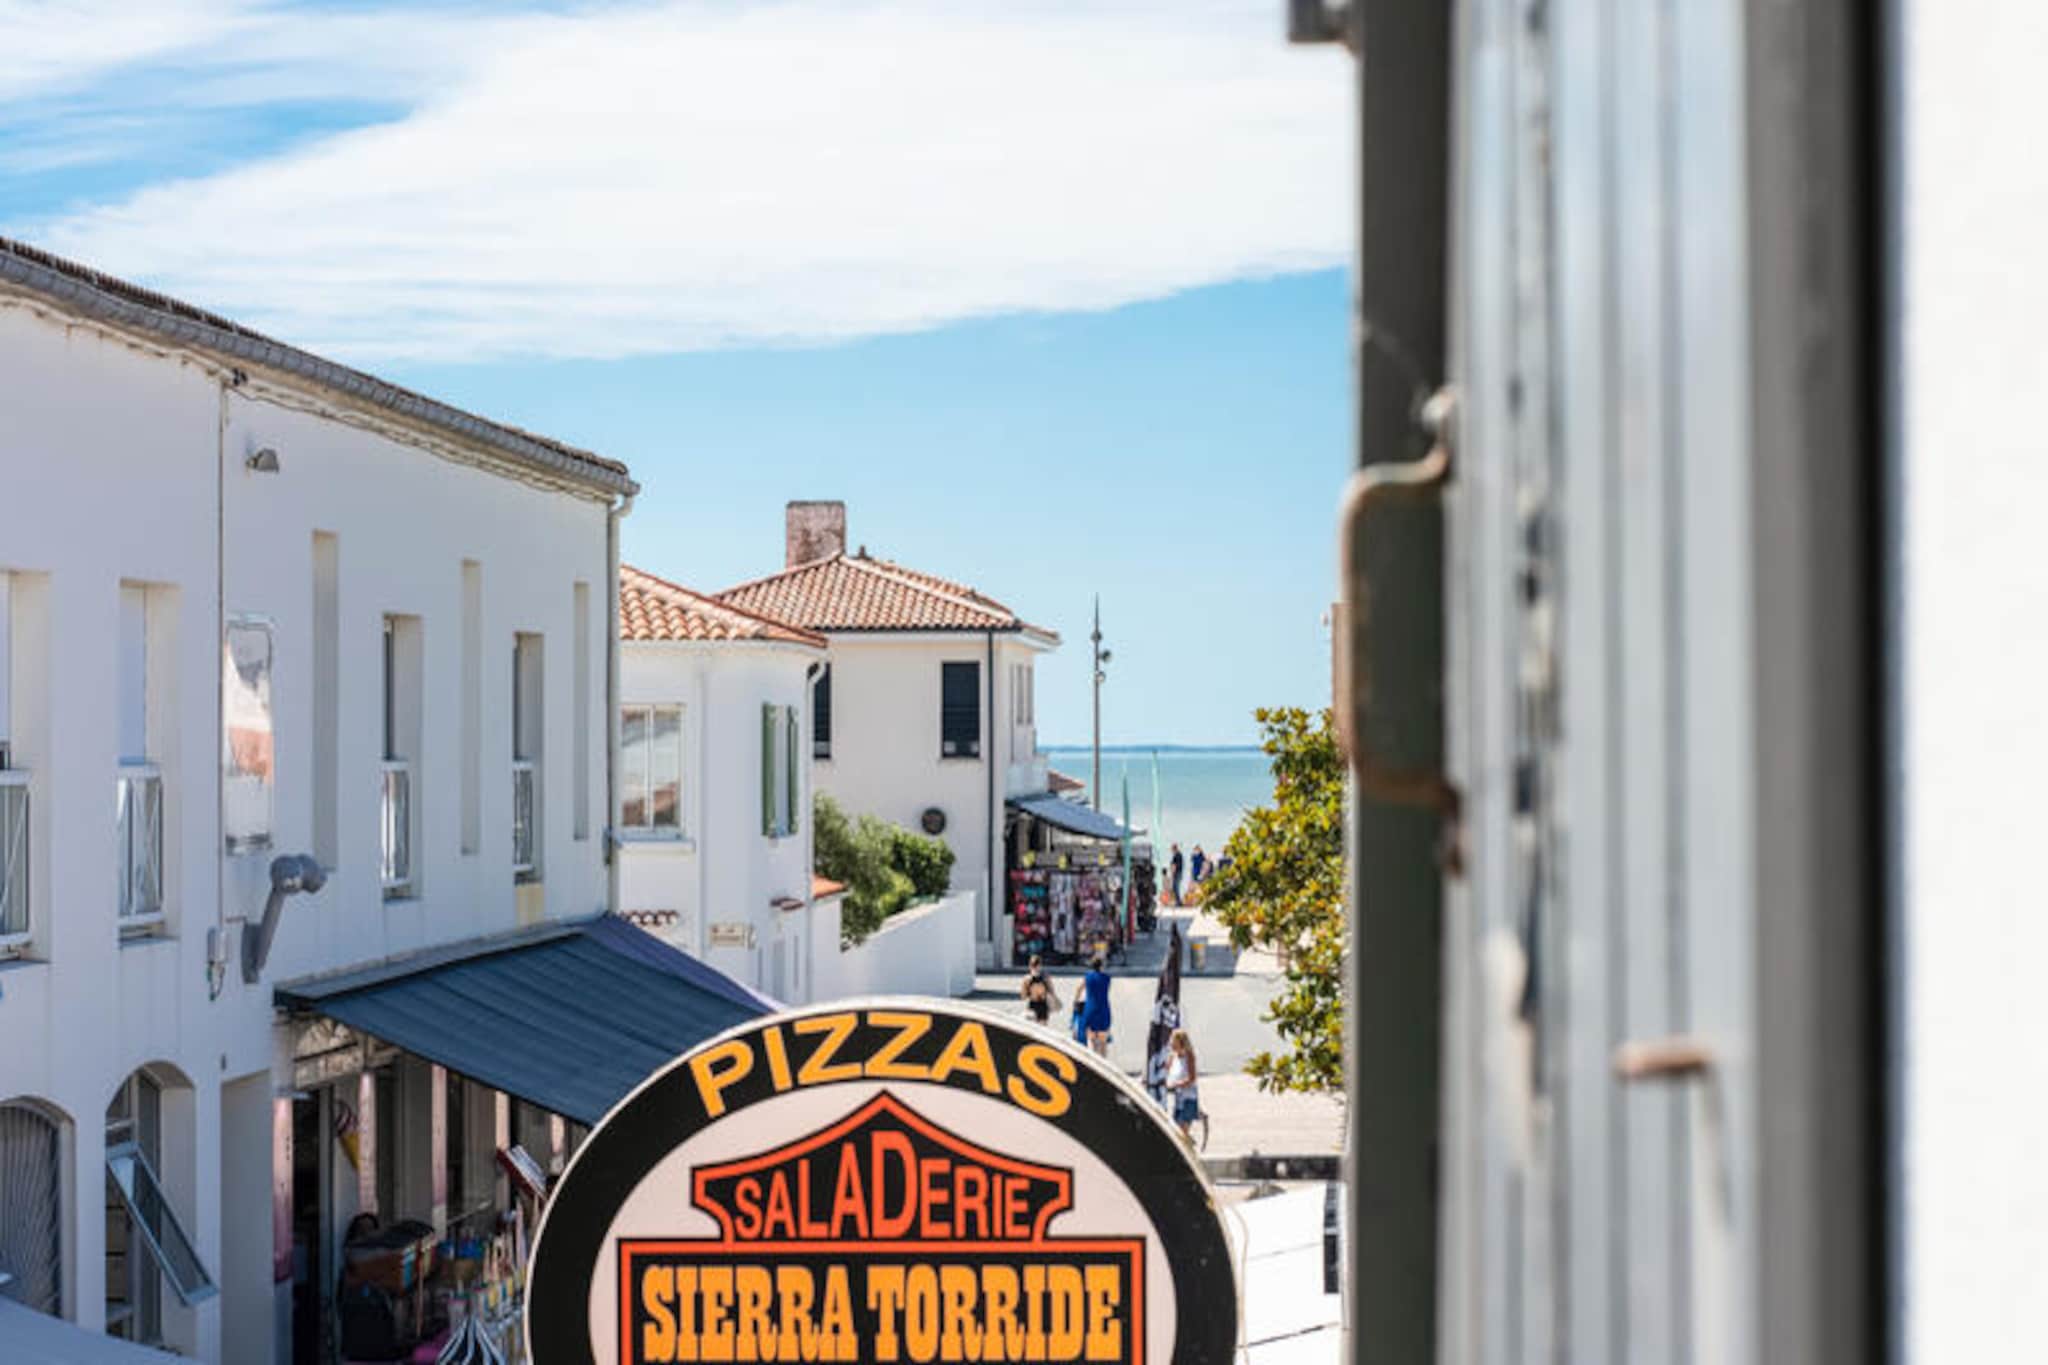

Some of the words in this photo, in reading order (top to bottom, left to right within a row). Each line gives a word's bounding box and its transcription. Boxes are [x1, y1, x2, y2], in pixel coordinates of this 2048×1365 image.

[689, 1011, 1078, 1117] PIZZAS
[734, 1130, 1032, 1240] SALADERIE
[642, 1264, 859, 1363] SIERRA
[867, 1264, 1122, 1363] TORRIDE
